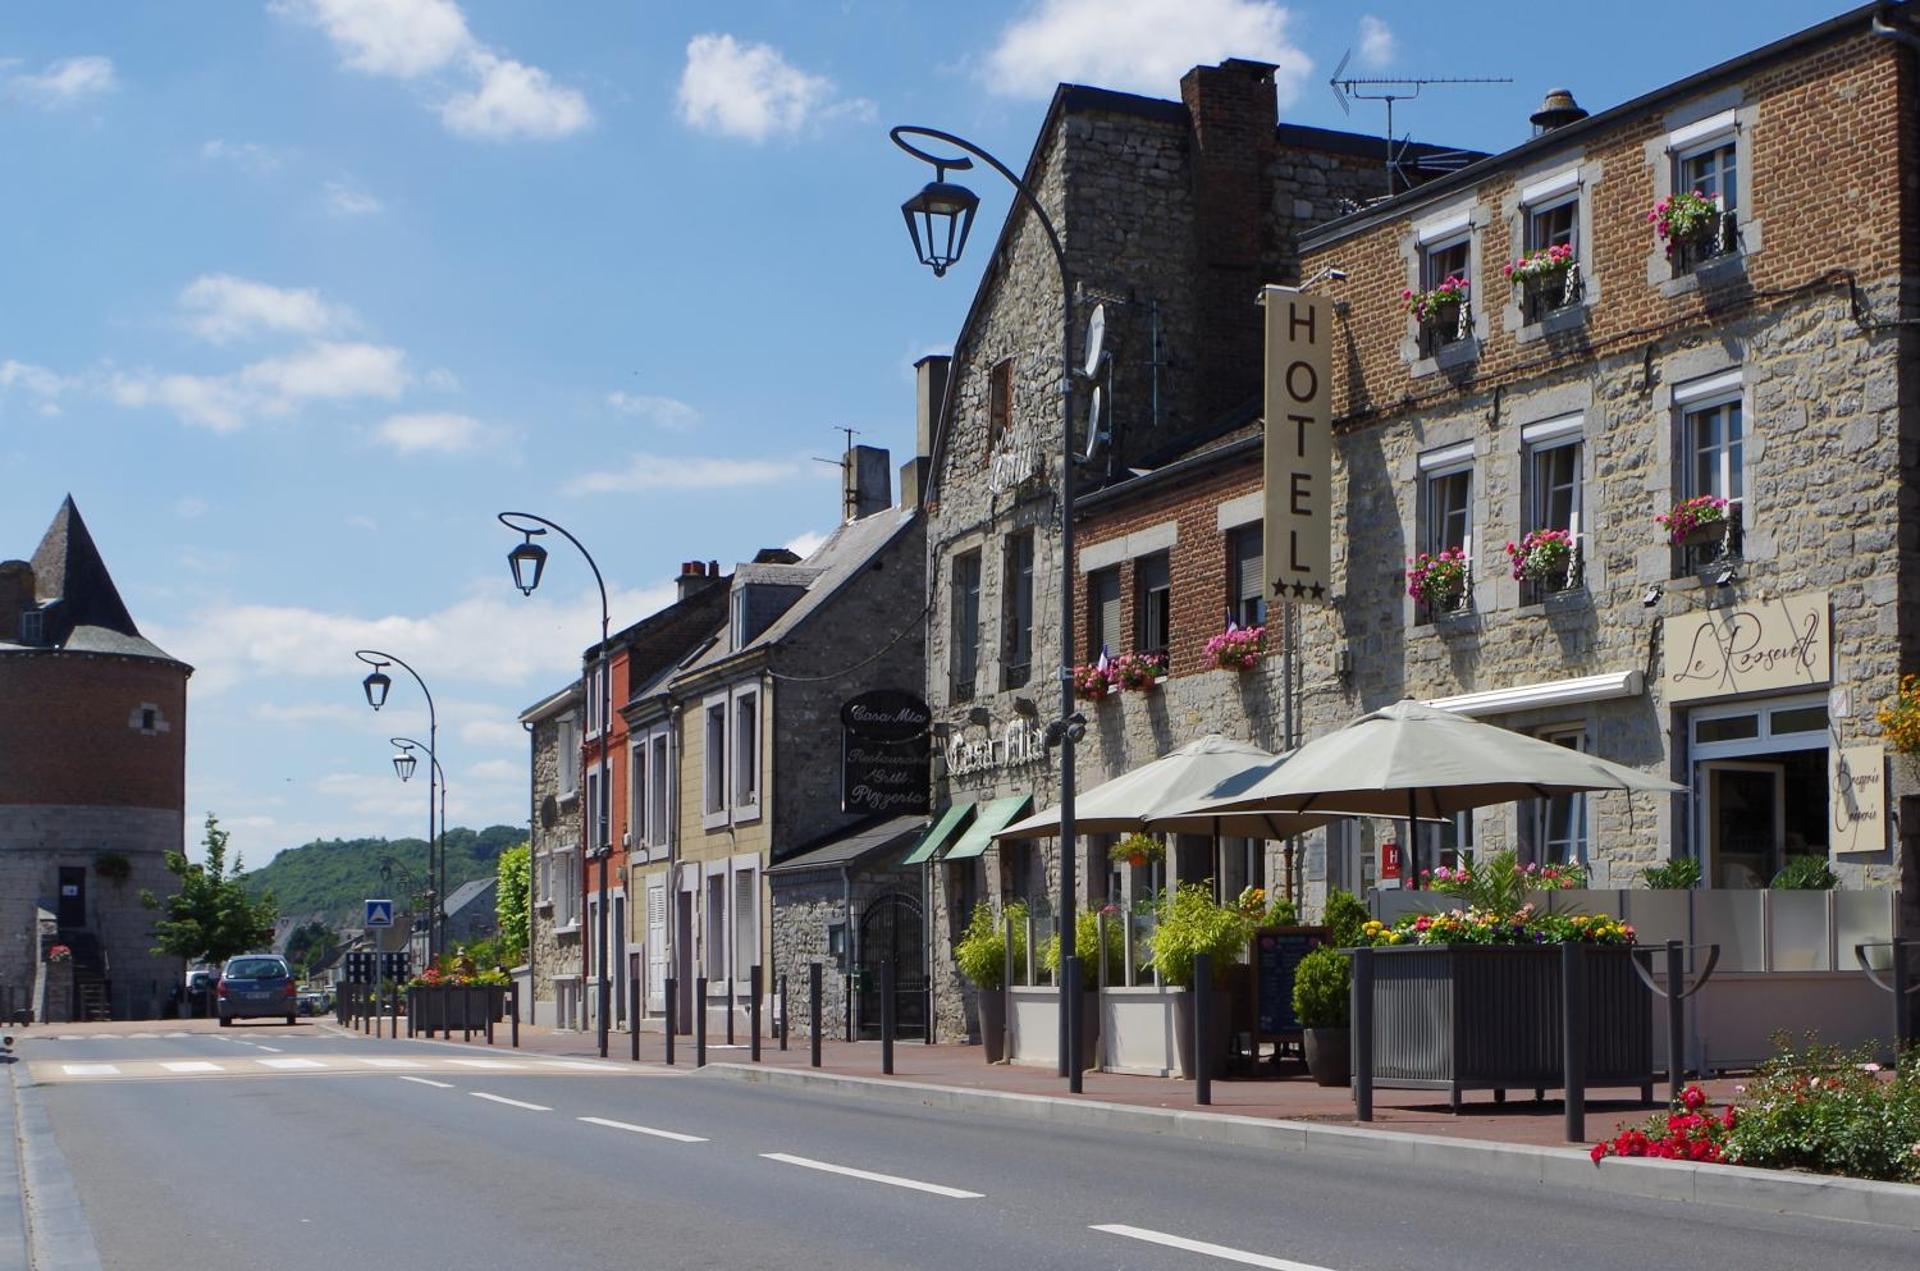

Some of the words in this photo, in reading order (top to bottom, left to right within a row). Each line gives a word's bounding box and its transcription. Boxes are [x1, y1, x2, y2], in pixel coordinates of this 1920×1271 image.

[1286, 303, 1318, 573] HOTEL
[1673, 622, 1720, 682] Le
[1717, 608, 1819, 690] Roosevelt
[850, 704, 891, 722] Casa
[892, 707, 927, 723] Mia
[945, 732, 994, 776] Casa
[850, 784, 928, 810] Pizzeria
[1389, 849, 1399, 864] H
